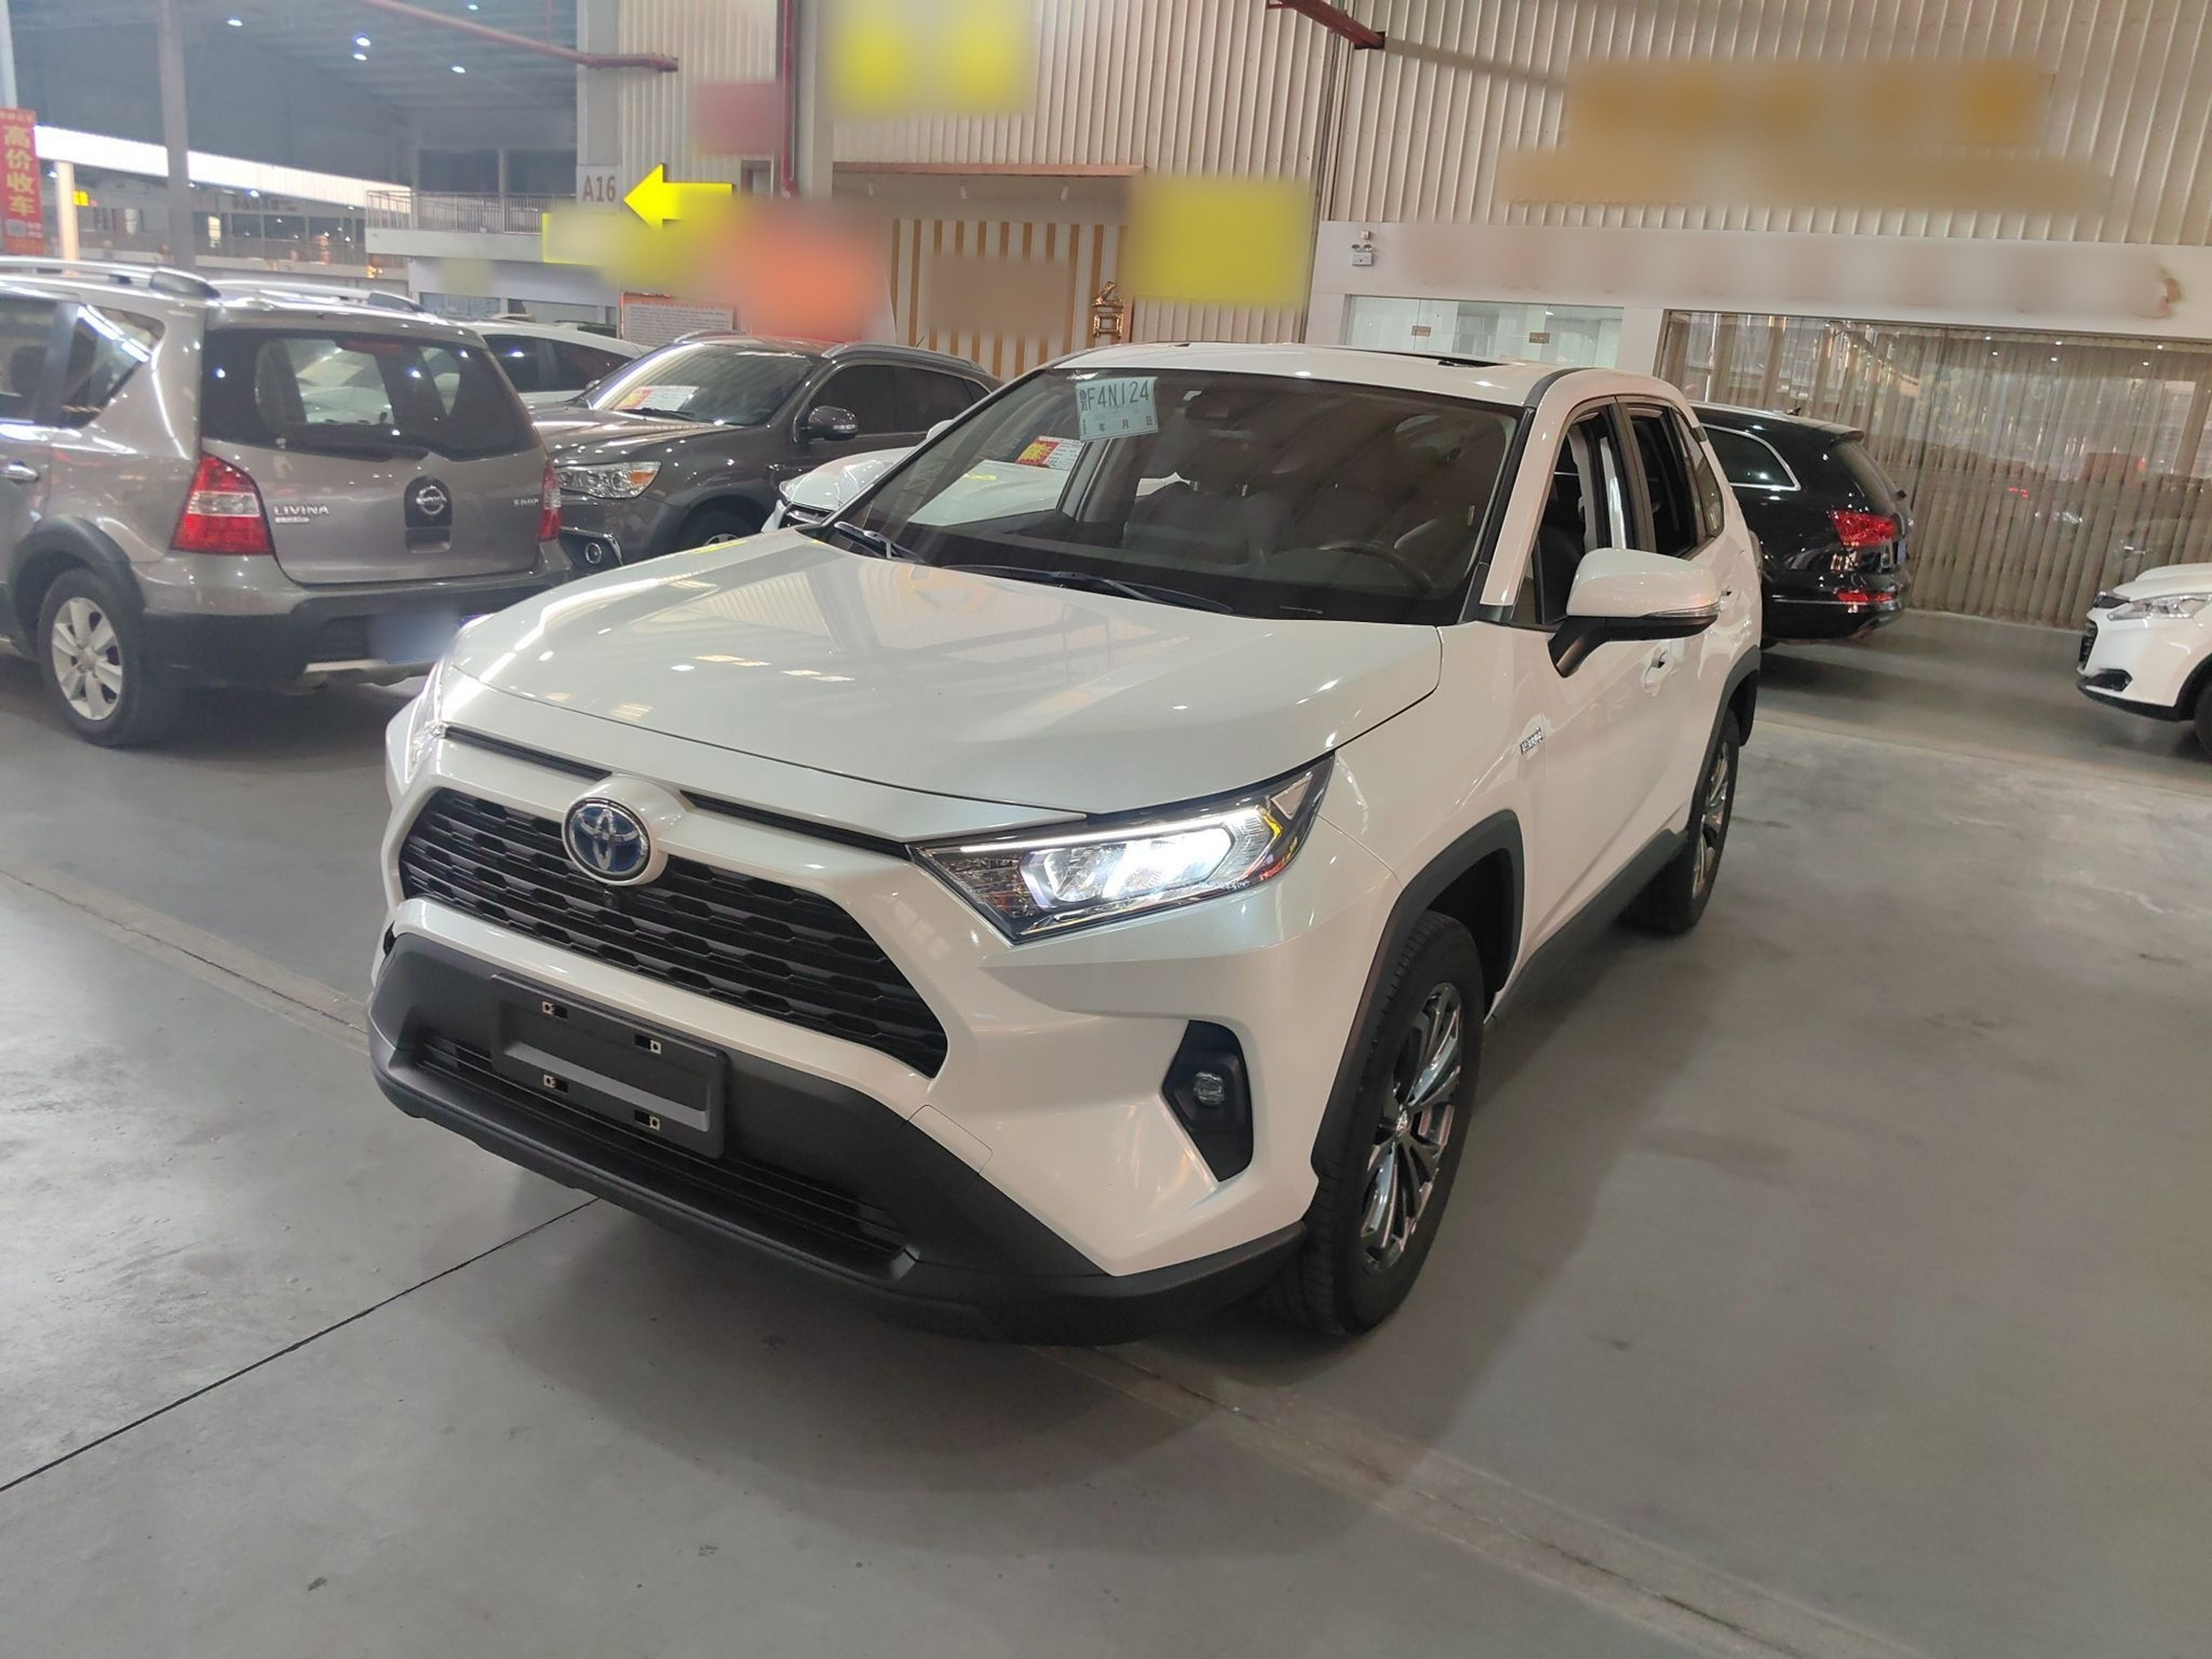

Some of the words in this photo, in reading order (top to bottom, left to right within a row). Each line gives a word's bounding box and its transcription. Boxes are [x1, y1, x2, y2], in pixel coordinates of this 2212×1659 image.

[4, 125, 35, 217] 高价收车
[582, 175, 616, 202] A16
[1146, 415, 1152, 426] 日
[274, 505, 329, 516] LIVINA
